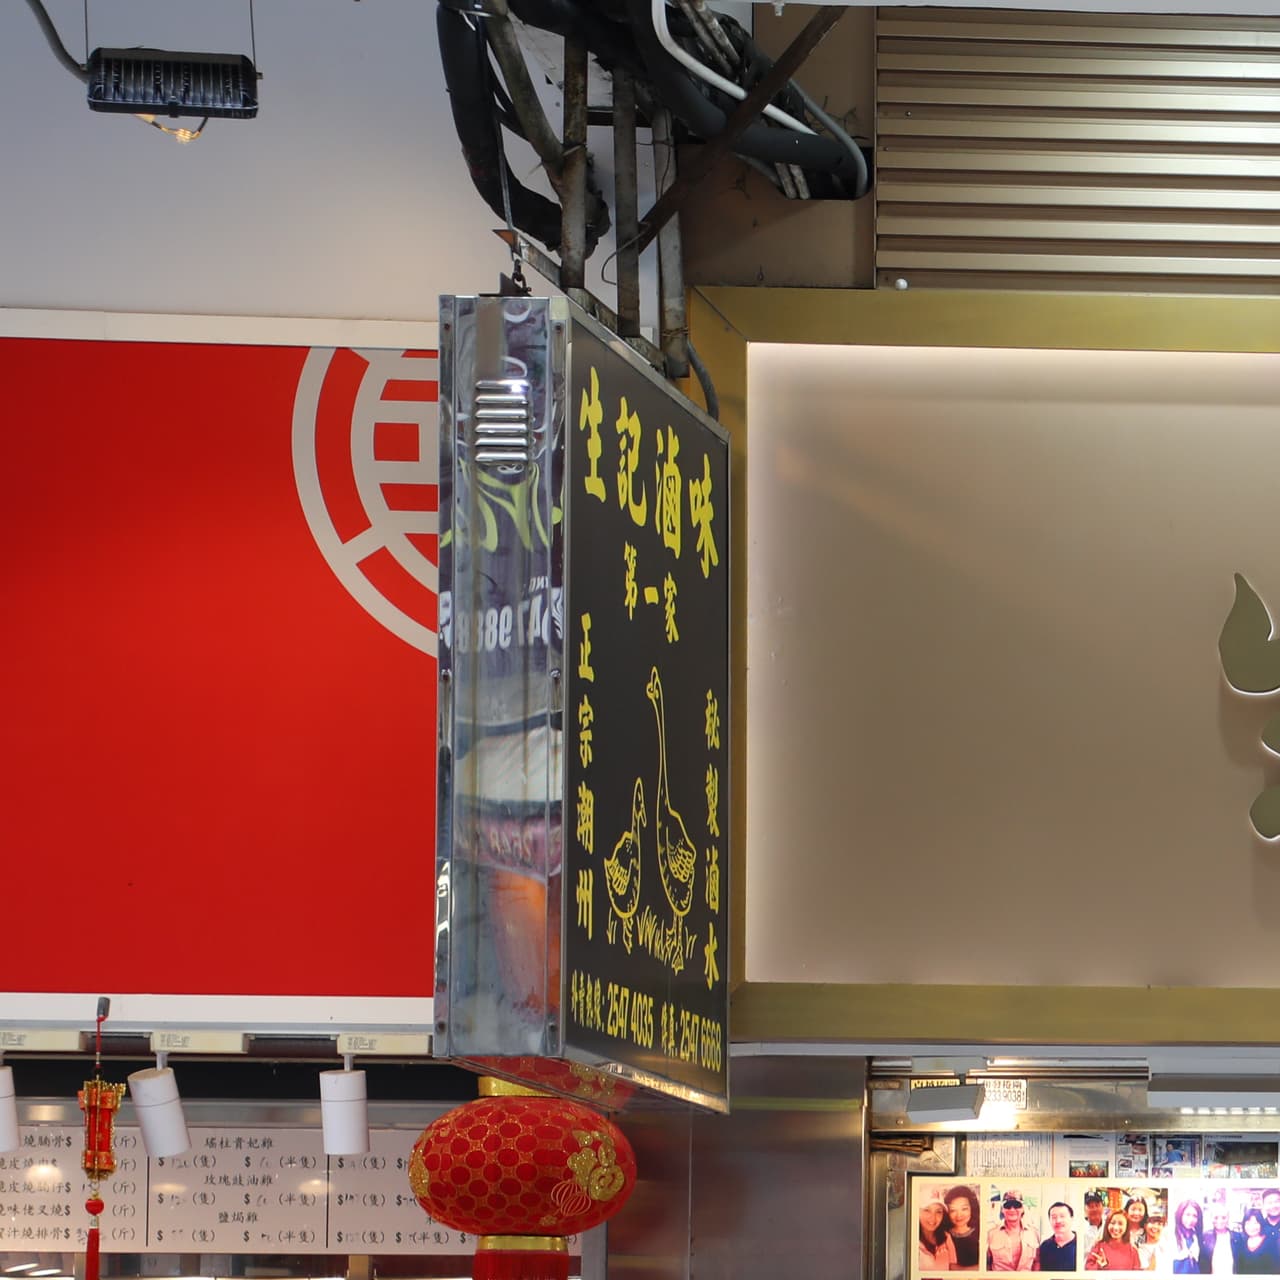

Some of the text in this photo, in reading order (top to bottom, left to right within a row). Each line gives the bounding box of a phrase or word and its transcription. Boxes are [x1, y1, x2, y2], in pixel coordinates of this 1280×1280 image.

[578, 366, 720, 579] 生記滷味
[623, 542, 680, 645] 第一家
[576, 612, 594, 941] 正宗潮州
[704, 689, 721, 991] 秘製滷水
[607, 982, 630, 1040] 2547
[630, 991, 654, 1049] 4035
[680, 1008, 700, 1065] 2547
[701, 1016, 722, 1073] 6668
